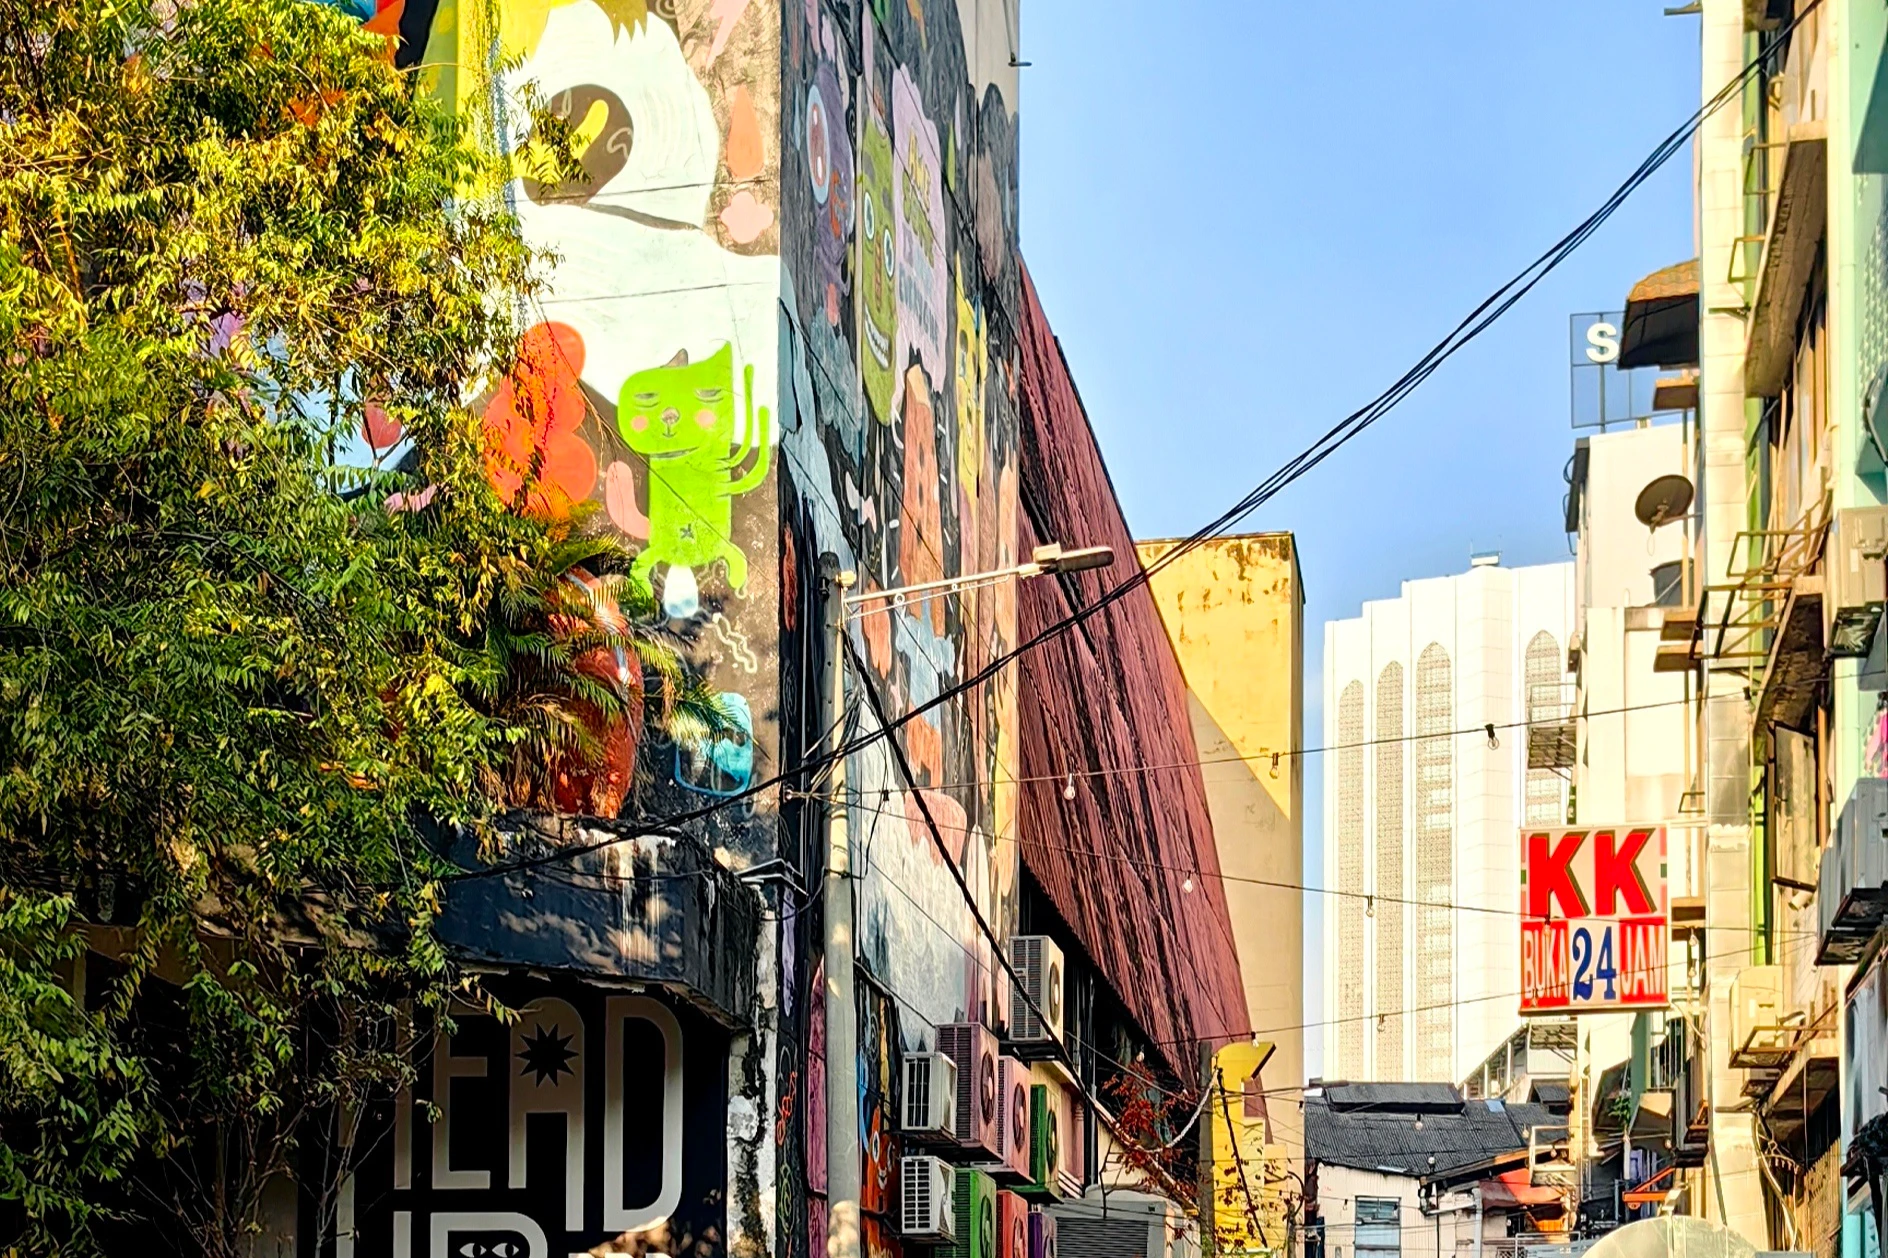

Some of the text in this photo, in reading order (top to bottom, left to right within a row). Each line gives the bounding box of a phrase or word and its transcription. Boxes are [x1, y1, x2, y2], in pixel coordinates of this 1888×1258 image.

[1529, 828, 1657, 919] KK
[1523, 924, 1667, 1001] BUKA 24 JAM
